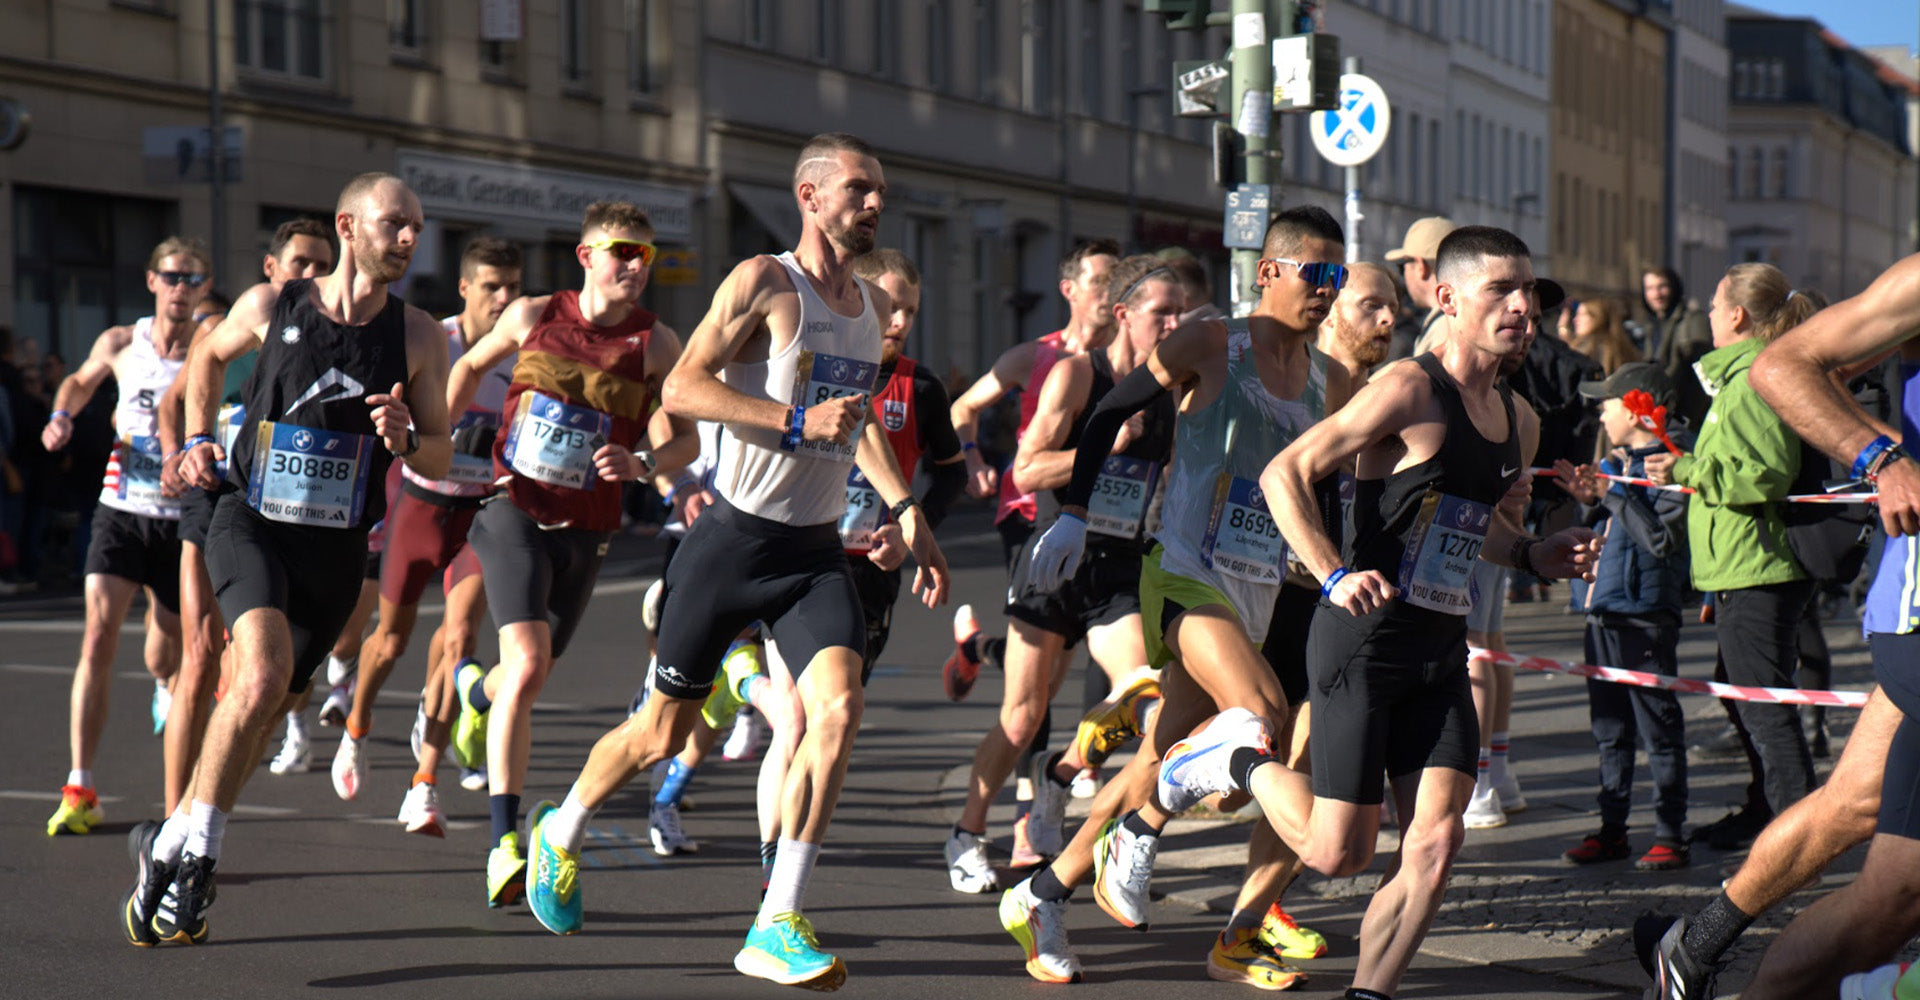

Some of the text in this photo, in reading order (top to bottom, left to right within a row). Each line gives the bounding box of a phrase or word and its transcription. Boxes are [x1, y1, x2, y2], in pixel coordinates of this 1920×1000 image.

[1228, 192, 1240, 207] S
[806, 321, 835, 334] HOKA
[534, 421, 585, 449] 17813
[819, 441, 837, 453] GOT
[271, 452, 350, 481] 30888
[845, 490, 875, 509] 45
[263, 501, 326, 520] YOU GOT THIS
[1213, 554, 1262, 577] YOU GOT THIS
[1412, 584, 1429, 600] YOU
[1429, 590, 1448, 604] GOT
[537, 846, 552, 897] HOKA
